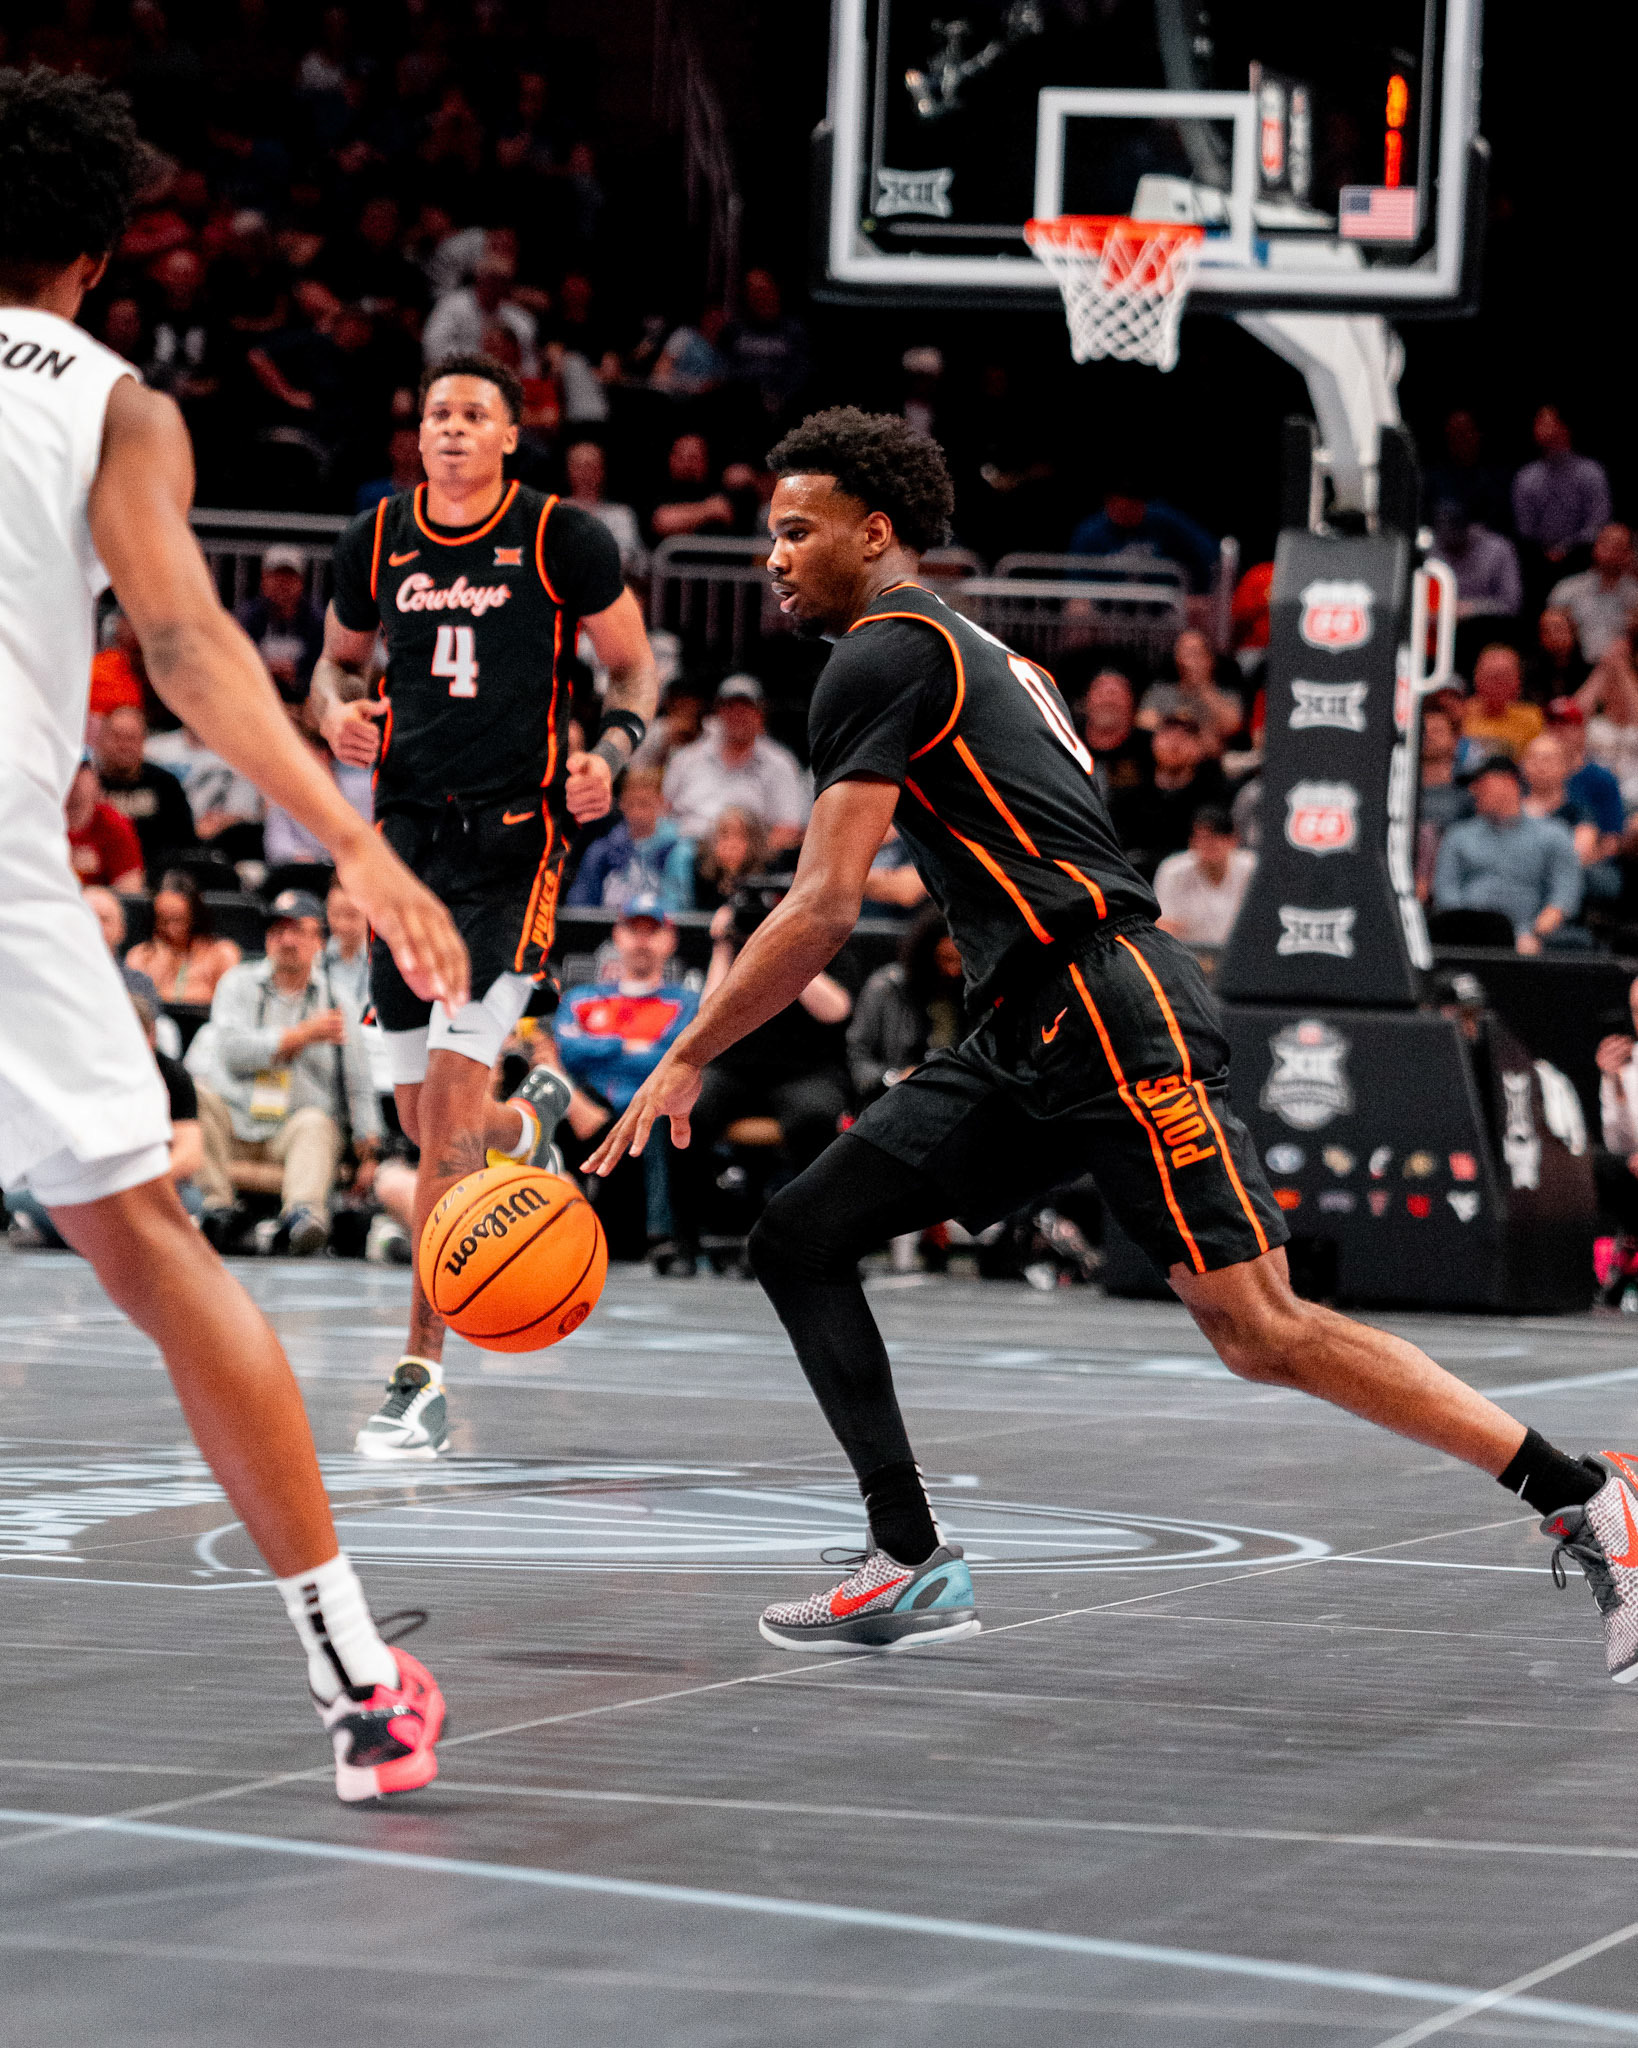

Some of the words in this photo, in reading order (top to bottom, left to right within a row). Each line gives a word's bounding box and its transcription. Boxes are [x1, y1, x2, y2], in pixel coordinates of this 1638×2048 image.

[0, 332, 76, 380] ON
[395, 572, 512, 617] Cowboys
[431, 624, 479, 698] 4
[1006, 653, 1094, 776] 0
[444, 1186, 551, 1276] Wilson
